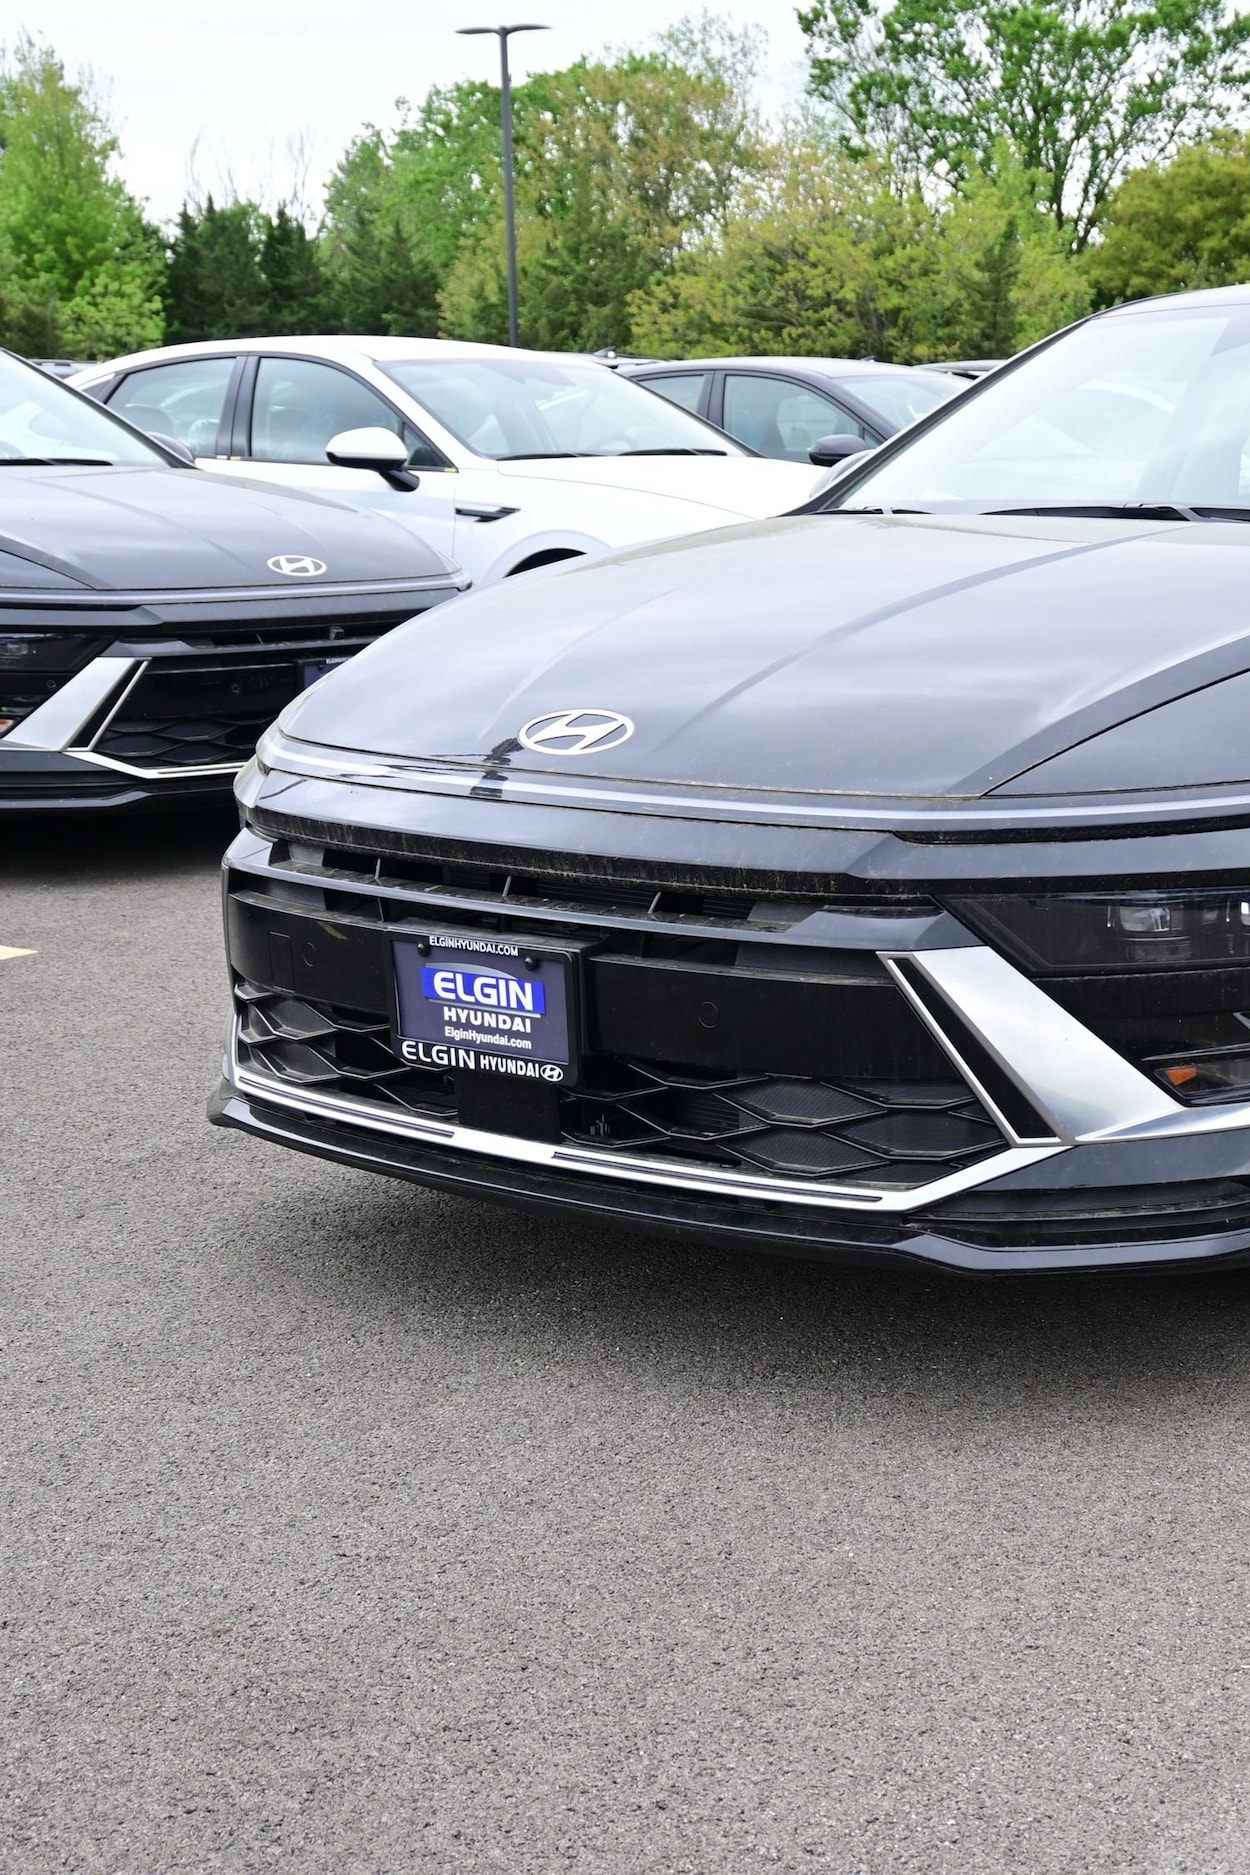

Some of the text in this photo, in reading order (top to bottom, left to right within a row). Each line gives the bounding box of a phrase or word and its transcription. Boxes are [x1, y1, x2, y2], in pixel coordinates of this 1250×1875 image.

[429, 935, 518, 956] ELGINHYUNDAI.COM
[433, 971, 534, 1011] ELGIN
[443, 1006, 531, 1033] HYUNDAI
[444, 1026, 532, 1050] ElginHyundai.com
[401, 1040, 539, 1078] ELGIN HYUNDAI
